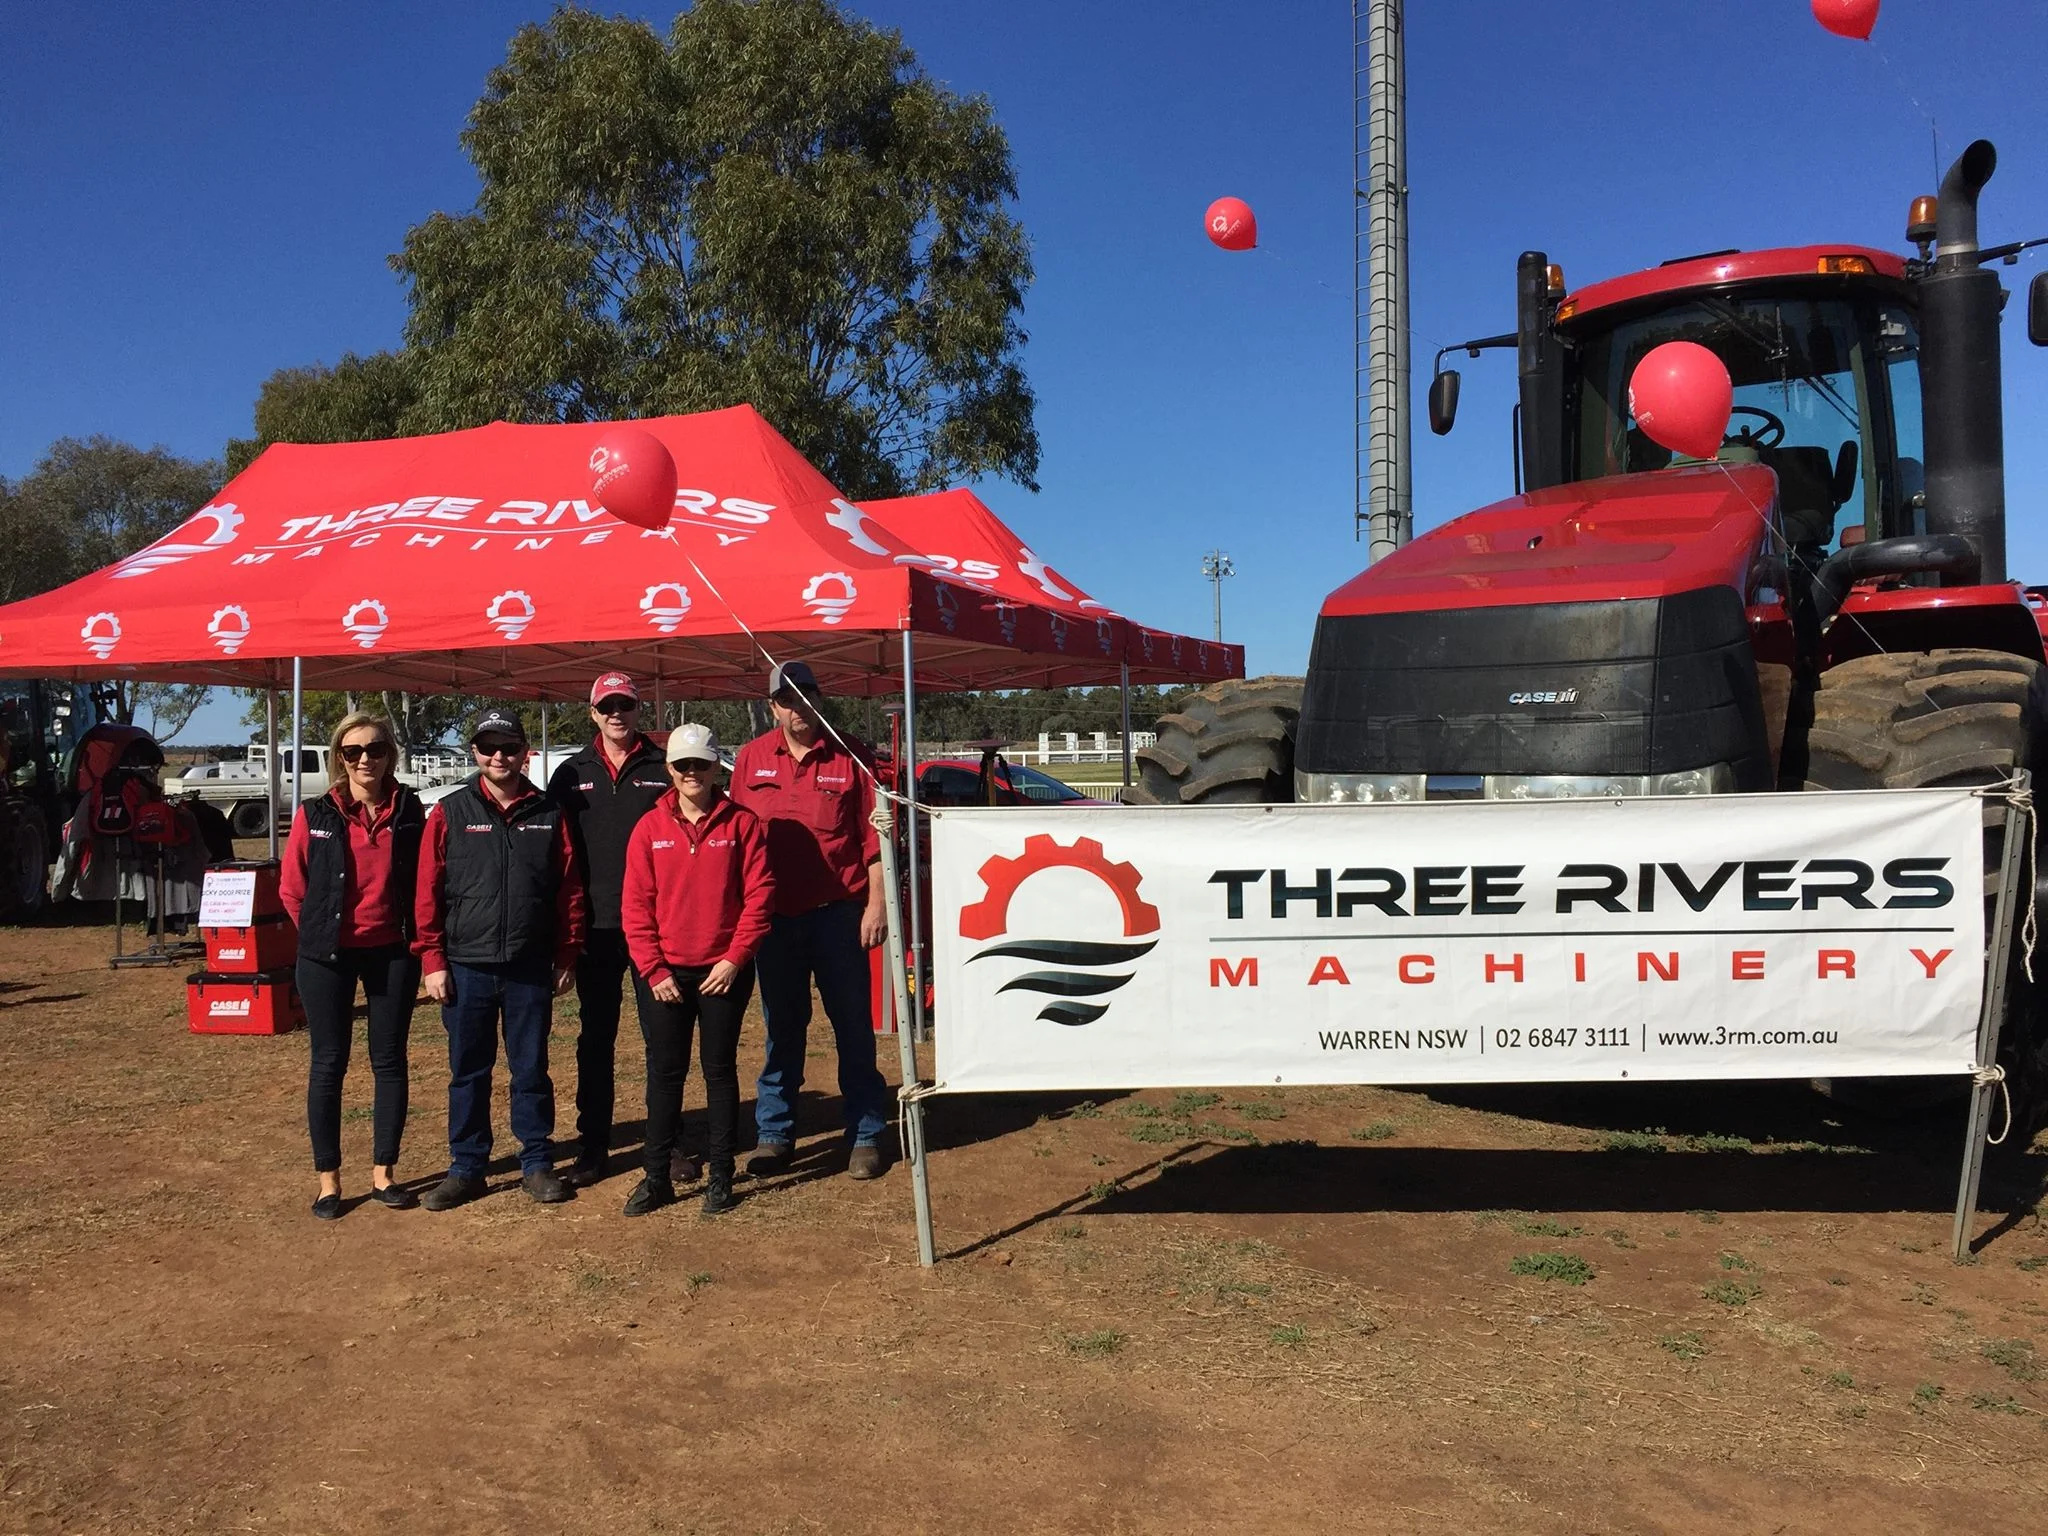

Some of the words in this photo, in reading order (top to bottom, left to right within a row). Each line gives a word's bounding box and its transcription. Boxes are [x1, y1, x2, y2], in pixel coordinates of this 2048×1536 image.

[277, 496, 484, 541] THREE
[485, 488, 777, 526] RIVRS
[231, 526, 748, 565] MACHINERY
[1509, 691, 1557, 704] CASE
[1208, 866, 1526, 920] THREE
[1556, 858, 1954, 913] RIVERS
[219, 948, 239, 956] CASE
[1210, 949, 1952, 988] MACHINERY
[210, 1000, 240, 1010] CASE
[1319, 1030, 1410, 1050] WARREN
[1418, 1029, 1468, 1049] NSW
[1496, 1028, 1521, 1048] 02
[1529, 1028, 1577, 1048] 6847
[1585, 1027, 1630, 1047] 3111
[1658, 1026, 1838, 1046] www.3rm.com.au
